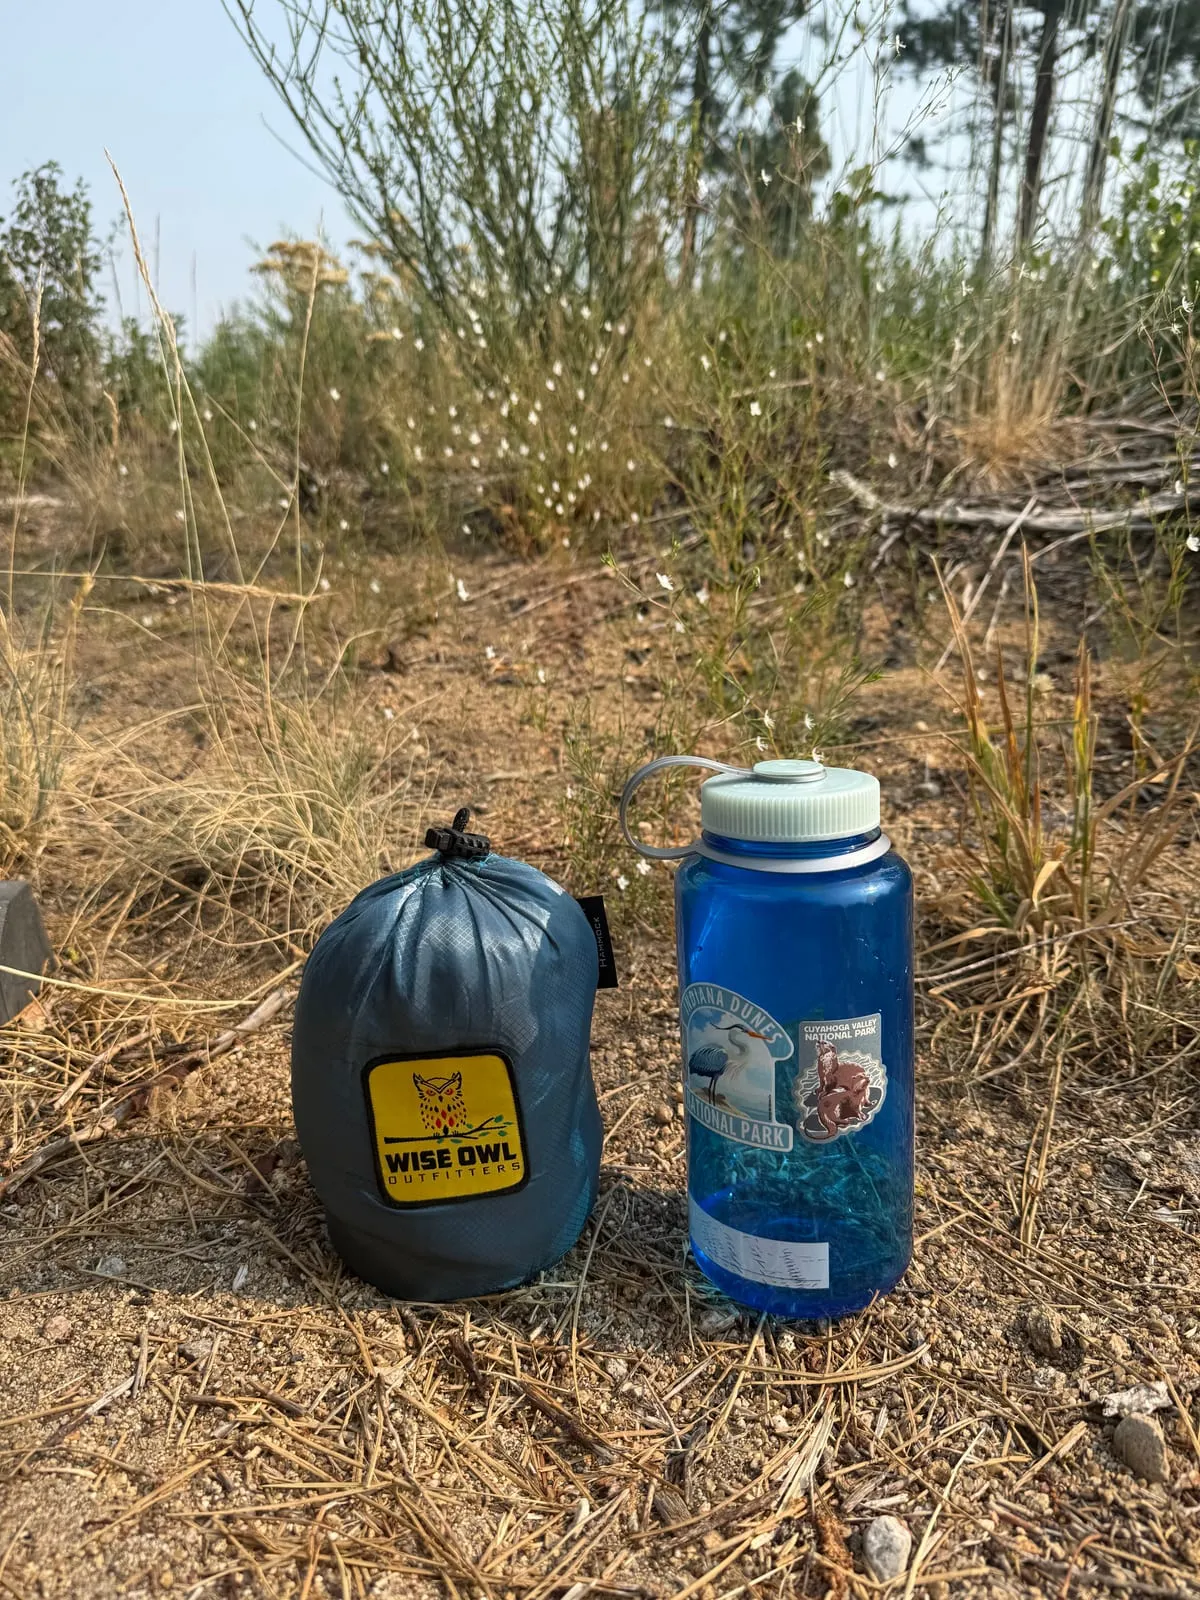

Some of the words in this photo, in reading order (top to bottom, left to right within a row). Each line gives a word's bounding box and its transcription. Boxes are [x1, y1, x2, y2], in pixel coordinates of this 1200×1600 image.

[593, 916, 608, 968] HAMMOCK
[683, 986, 725, 1016] INDIANA
[729, 996, 784, 1045] DUNES
[803, 1024, 850, 1033] CUYAHOGA
[851, 1018, 878, 1029] VALLEY
[804, 1030, 853, 1041] NATIONAL
[854, 1026, 877, 1038] PARK
[741, 1120, 784, 1147] PARK
[385, 1148, 453, 1174] WISE
[457, 1142, 517, 1166] OWL
[388, 1163, 521, 1185] OUTFITTERS
